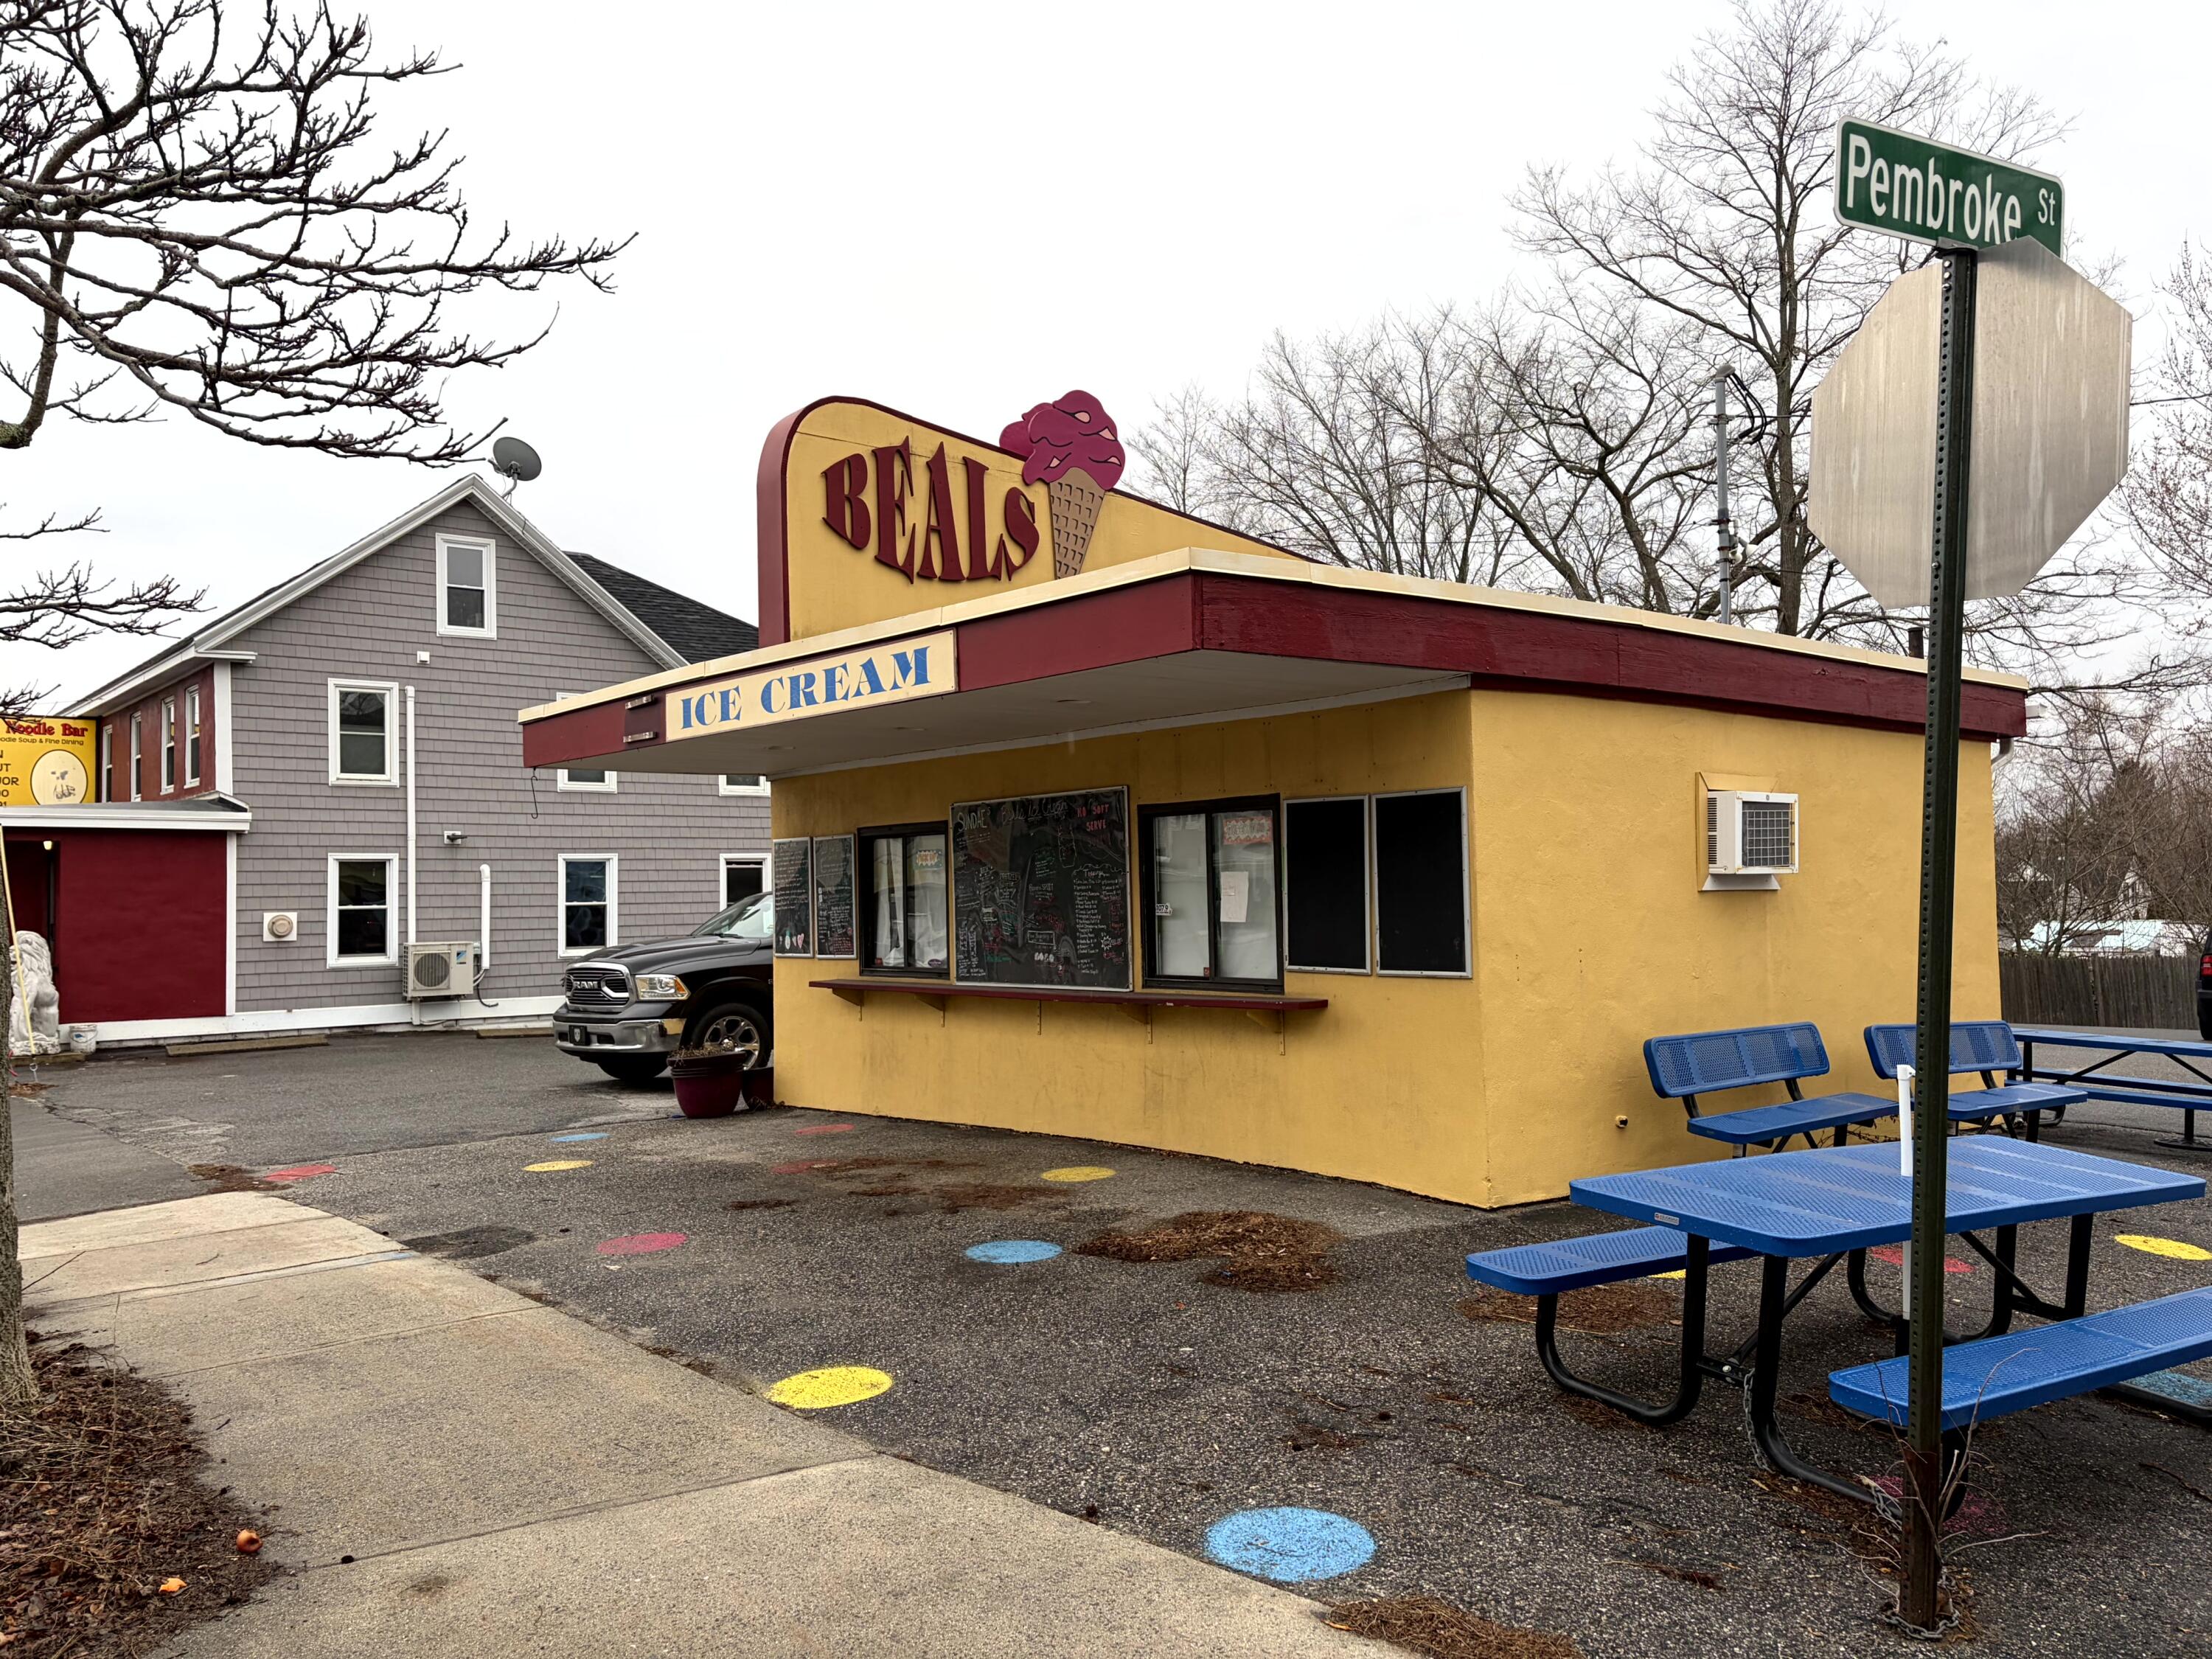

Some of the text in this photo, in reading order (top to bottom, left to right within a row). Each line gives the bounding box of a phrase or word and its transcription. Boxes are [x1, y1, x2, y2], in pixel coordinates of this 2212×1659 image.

[1846, 133, 2056, 245] Pembroke St
[820, 435, 1040, 585] BEALS
[681, 645, 931, 730] ICE CREAM
[5, 720, 88, 737] Noodle Bar
[0, 776, 19, 786] OR
[1092, 804, 1109, 815] SOFT
[1086, 819, 1107, 832] SERVE
[573, 981, 598, 989] RAM
